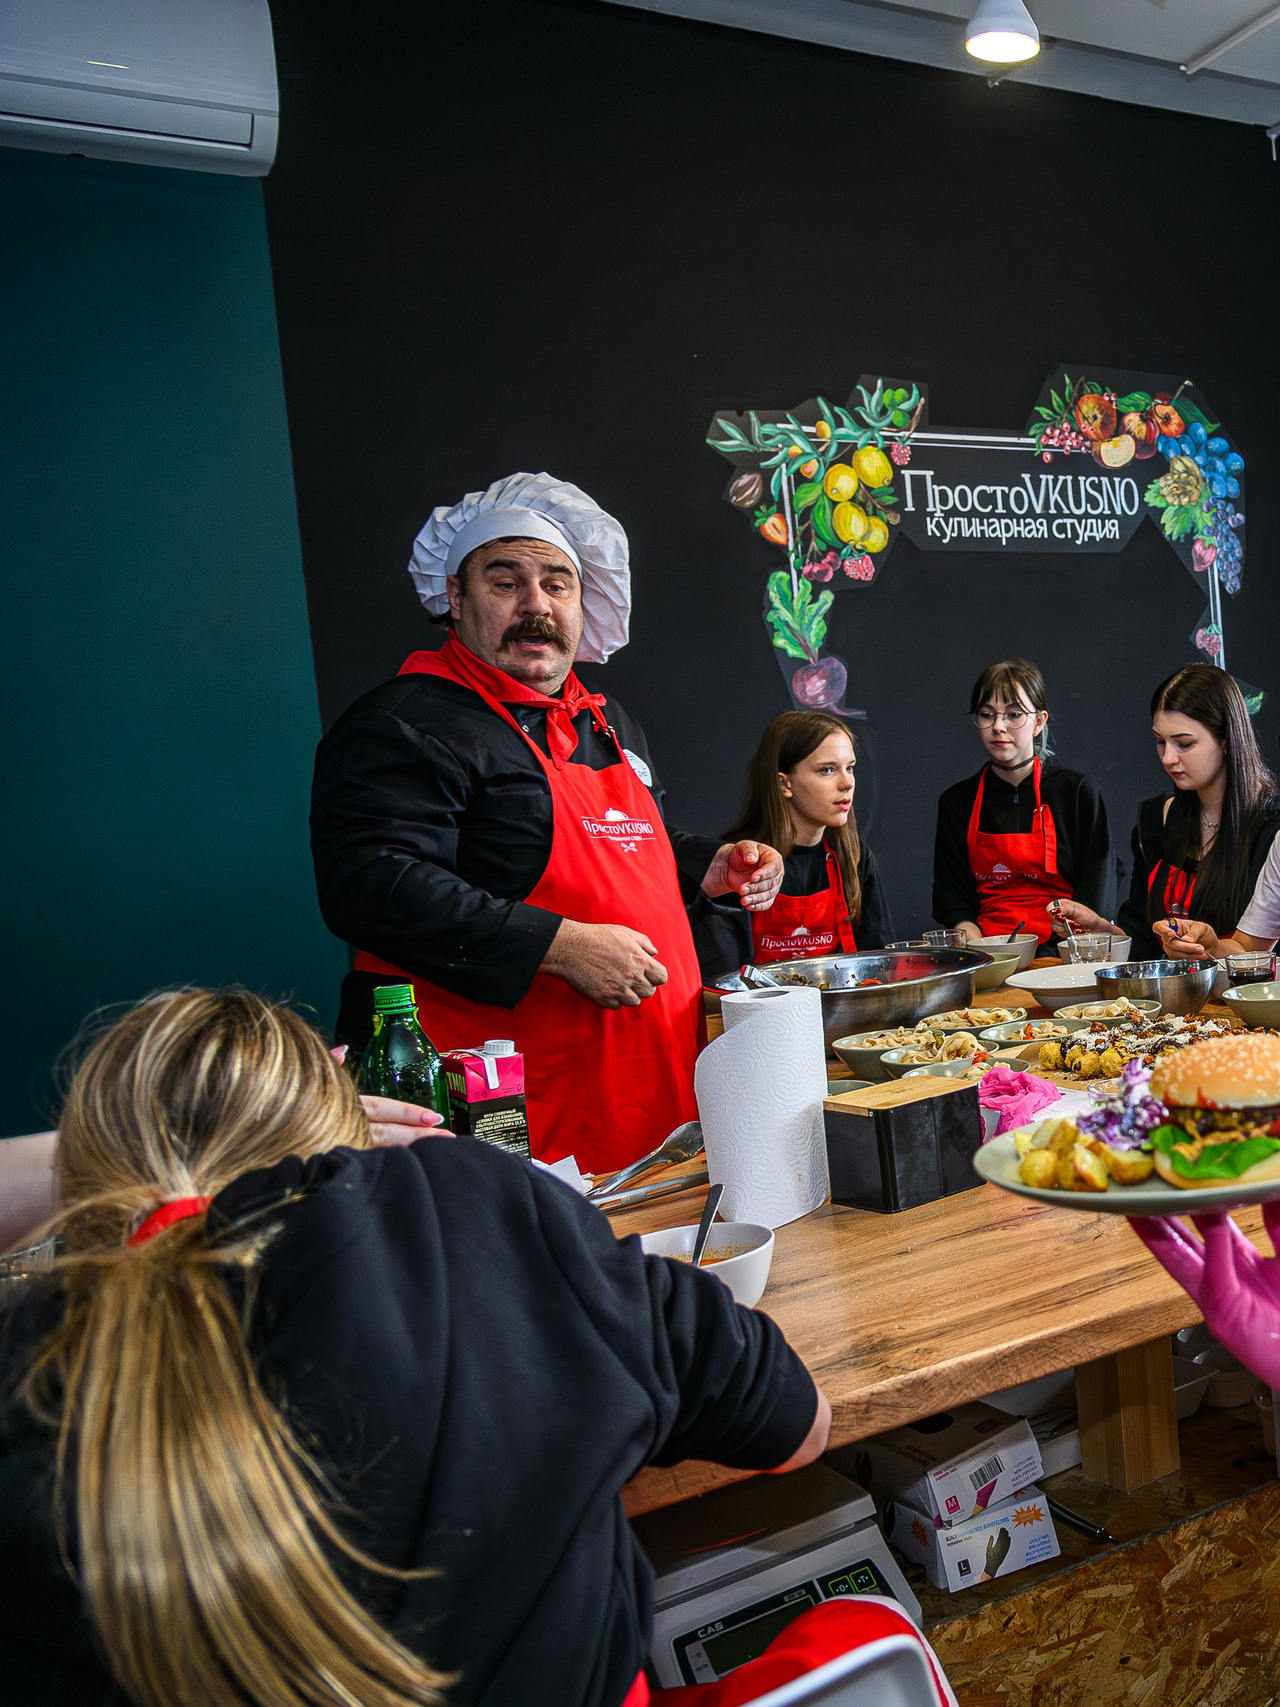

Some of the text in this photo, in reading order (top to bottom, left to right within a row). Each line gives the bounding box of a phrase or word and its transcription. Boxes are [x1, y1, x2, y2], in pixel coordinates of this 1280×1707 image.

[901, 469, 1139, 516] ПростоVKUSNO
[926, 516, 1120, 545] кулинарная студия
[582, 820, 654, 835] ПростоVKUSNO
[761, 934, 834, 949] ПростоVKUSNO
[947, 1497, 957, 1508] M
[960, 1562, 968, 1571] L
[697, 1621, 724, 1638] CAS
